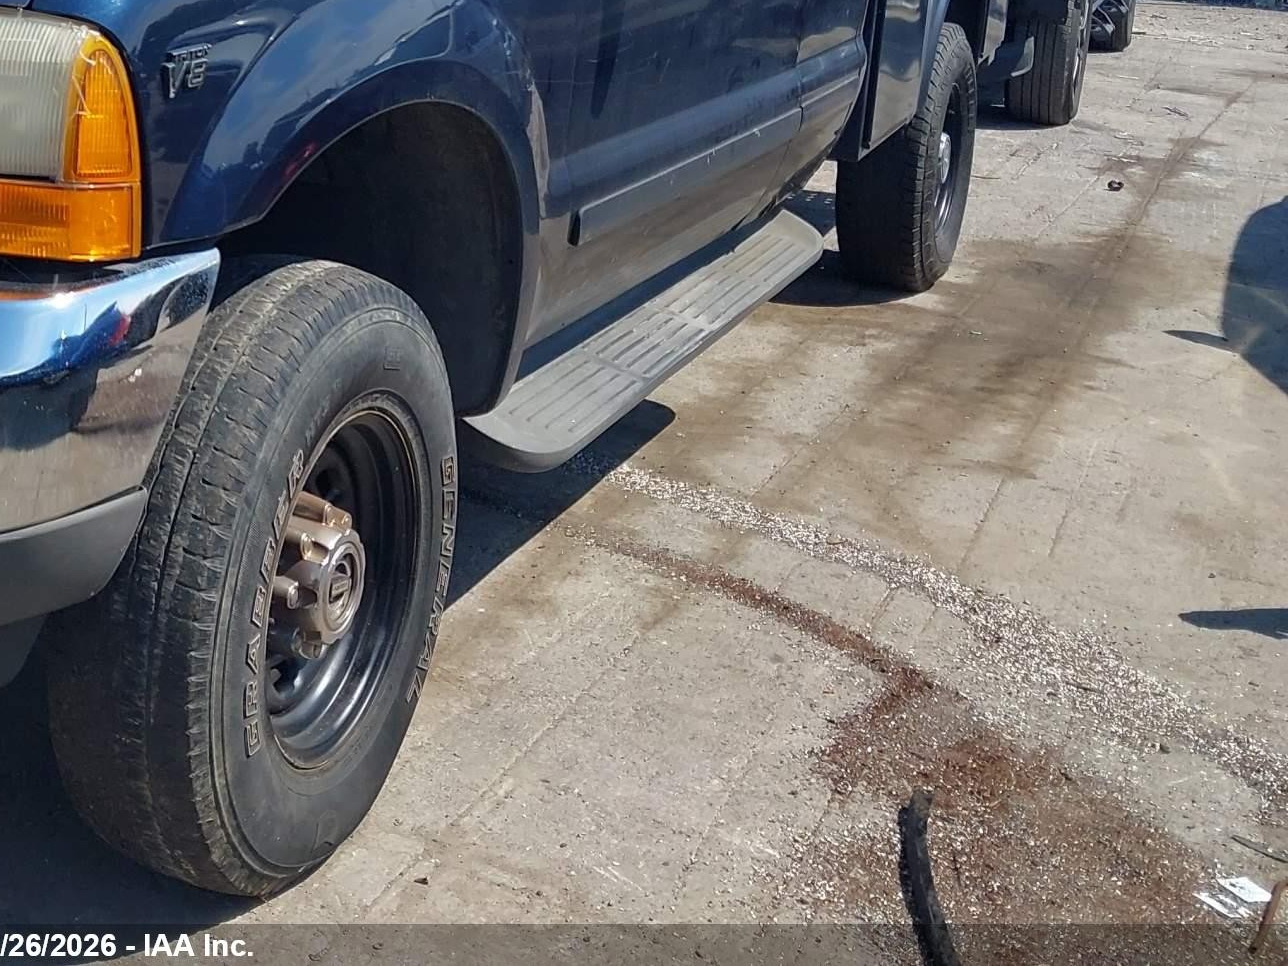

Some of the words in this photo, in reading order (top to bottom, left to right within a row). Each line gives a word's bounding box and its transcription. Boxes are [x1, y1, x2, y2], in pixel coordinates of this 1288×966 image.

[161, 58, 209, 98] V8
[243, 448, 304, 758] GRABBER
[405, 455, 456, 704] GENERAL
